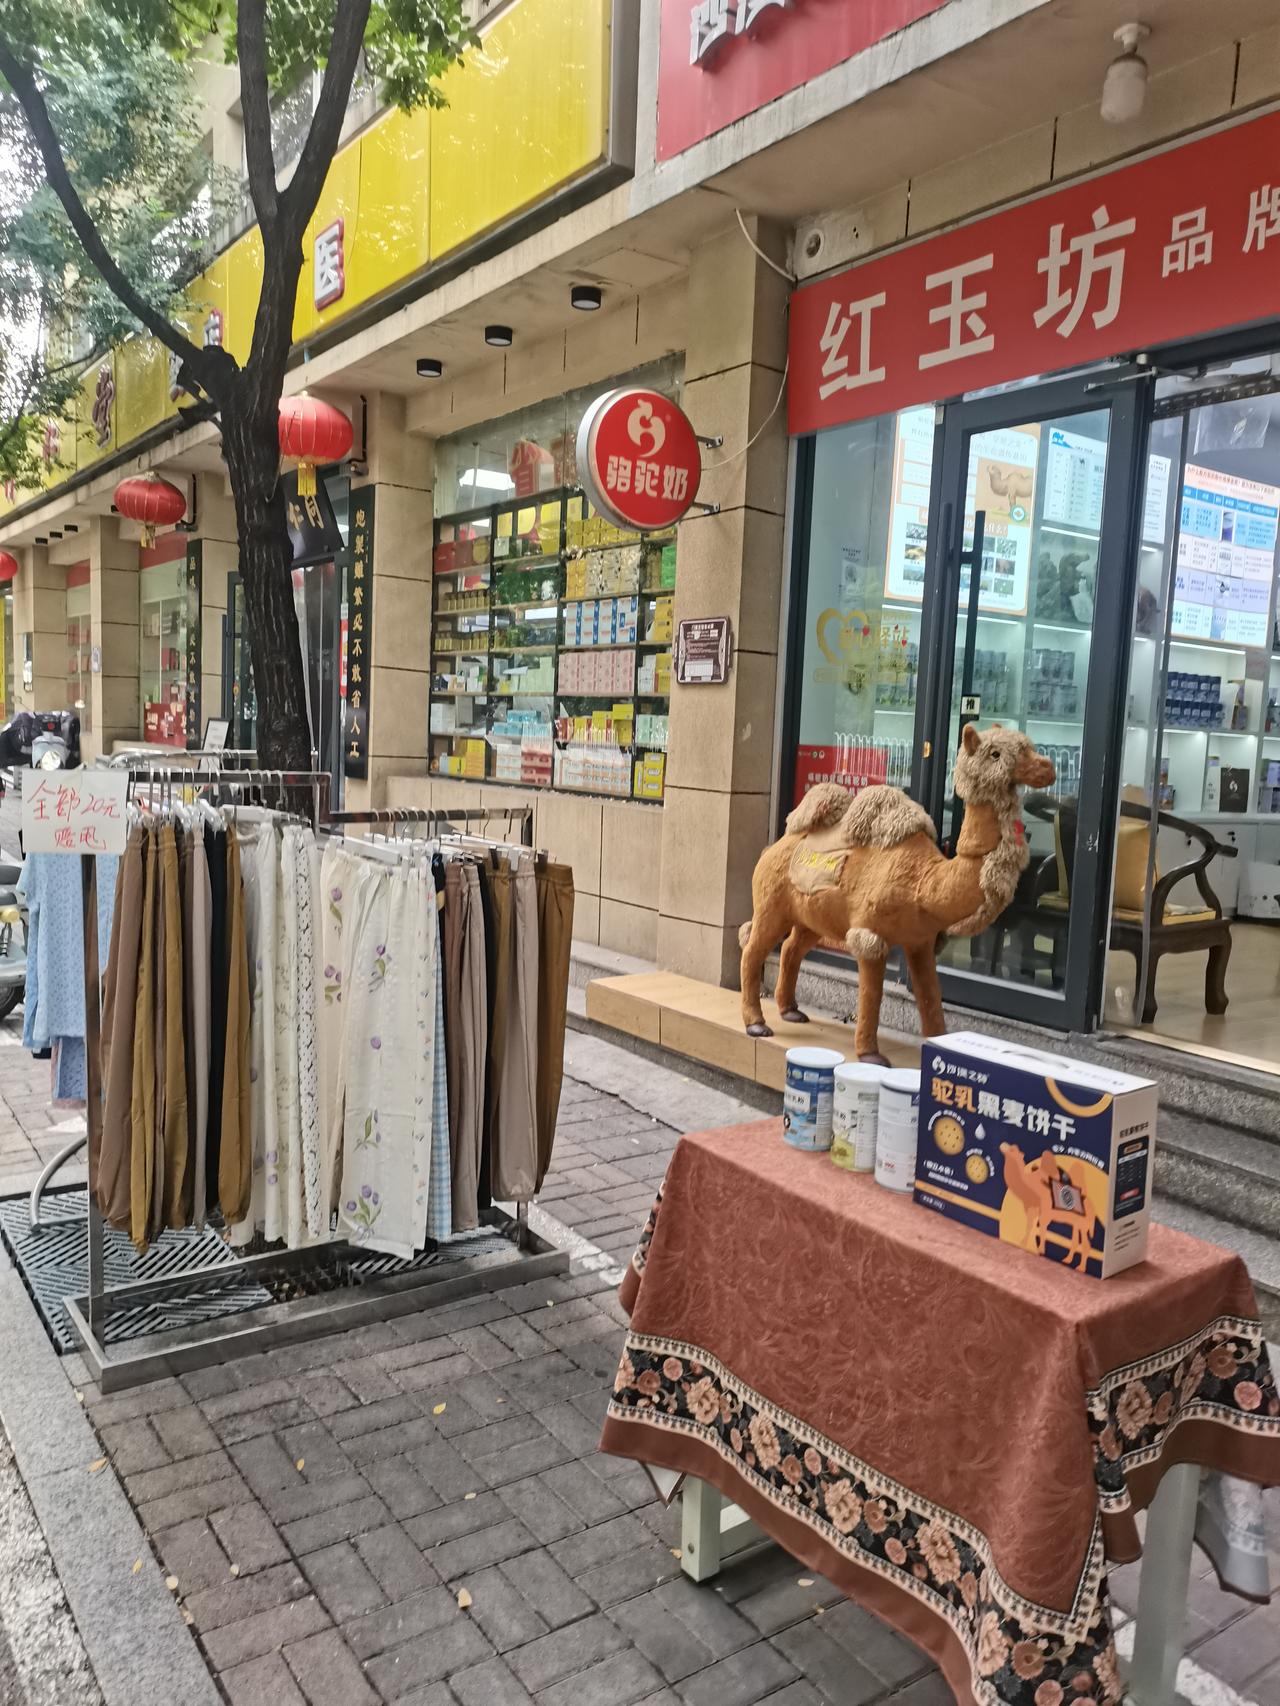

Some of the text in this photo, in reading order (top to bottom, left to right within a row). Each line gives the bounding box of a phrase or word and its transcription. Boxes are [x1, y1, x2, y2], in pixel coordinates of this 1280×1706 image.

[606, 455, 689, 501] 骆驼奶
[931, 1076, 1076, 1141] 驼乳黑麦饼干
